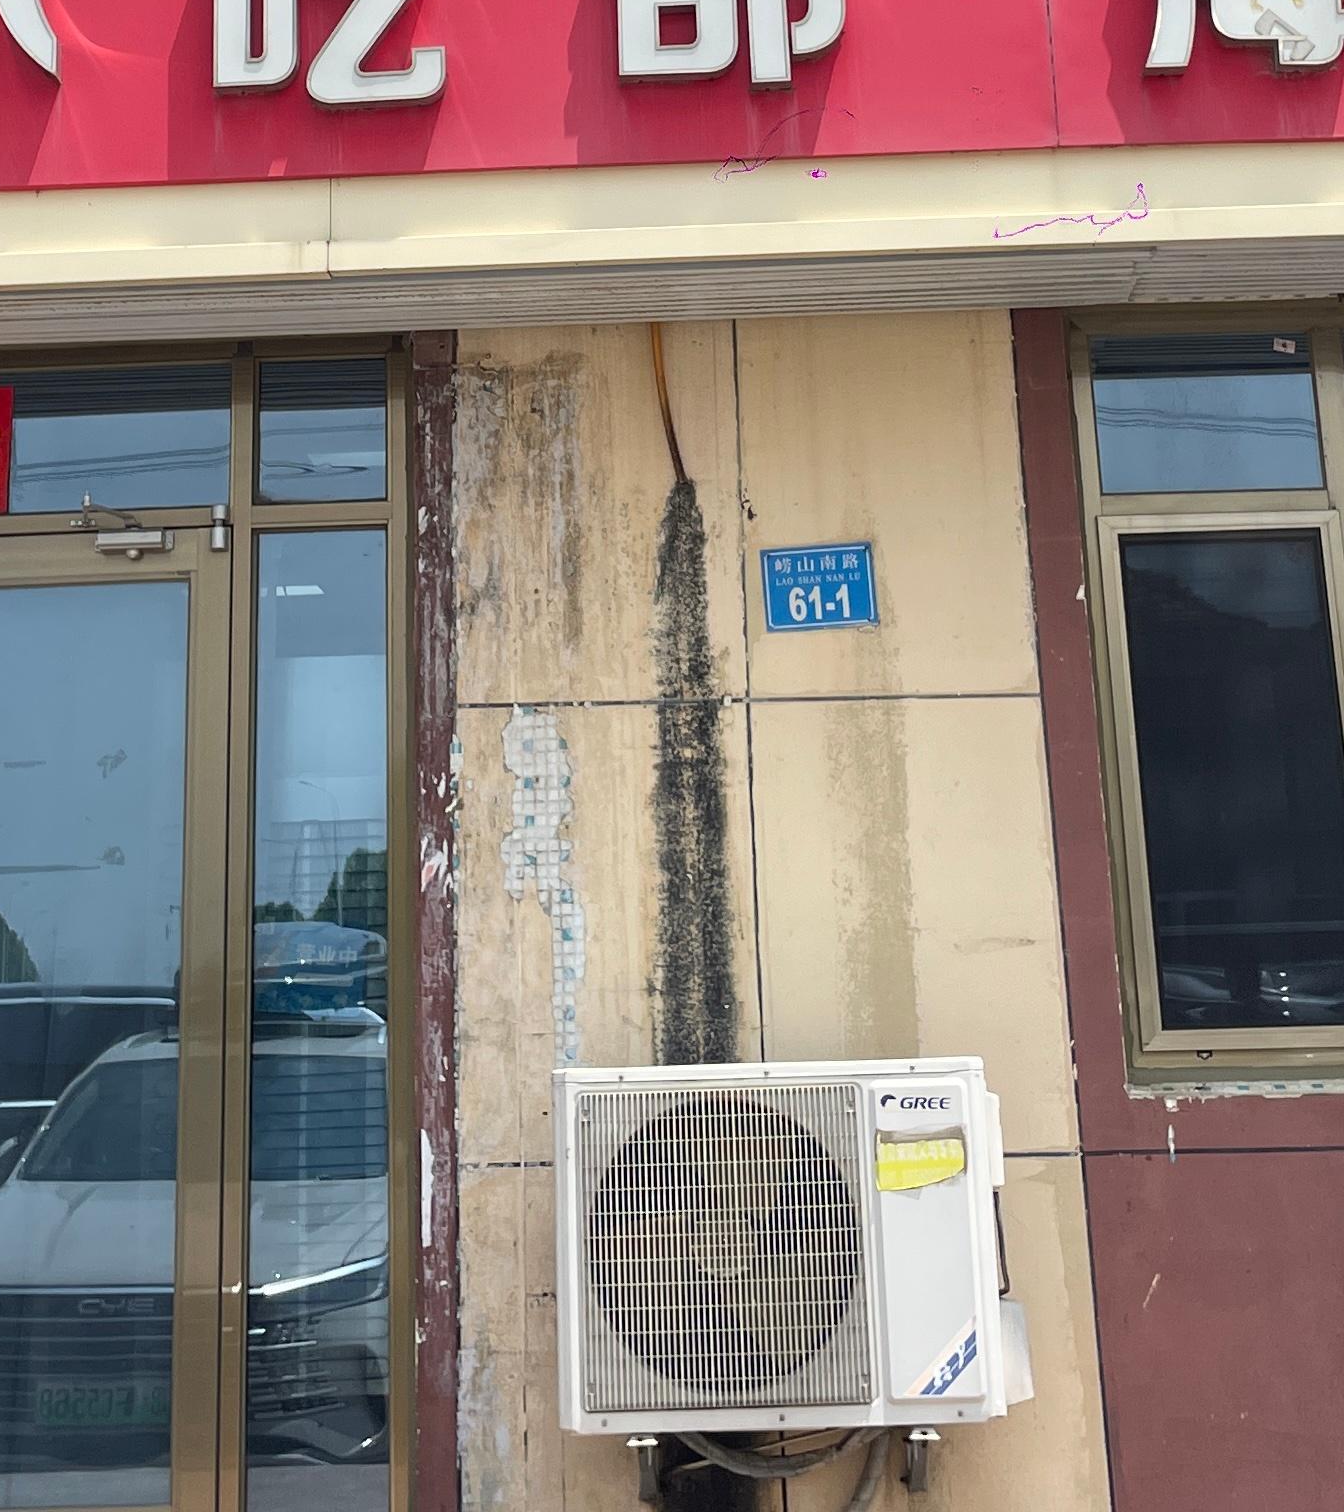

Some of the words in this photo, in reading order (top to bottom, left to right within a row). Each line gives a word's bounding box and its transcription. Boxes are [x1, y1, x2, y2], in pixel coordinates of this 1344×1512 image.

[775, 554, 859, 574] 崂山南路
[776, 577, 794, 586] LAO
[798, 575, 822, 584] SHAN
[826, 573, 845, 583] NAN
[789, 585, 850, 621] 61-1
[900, 1096, 951, 1110] GREE
